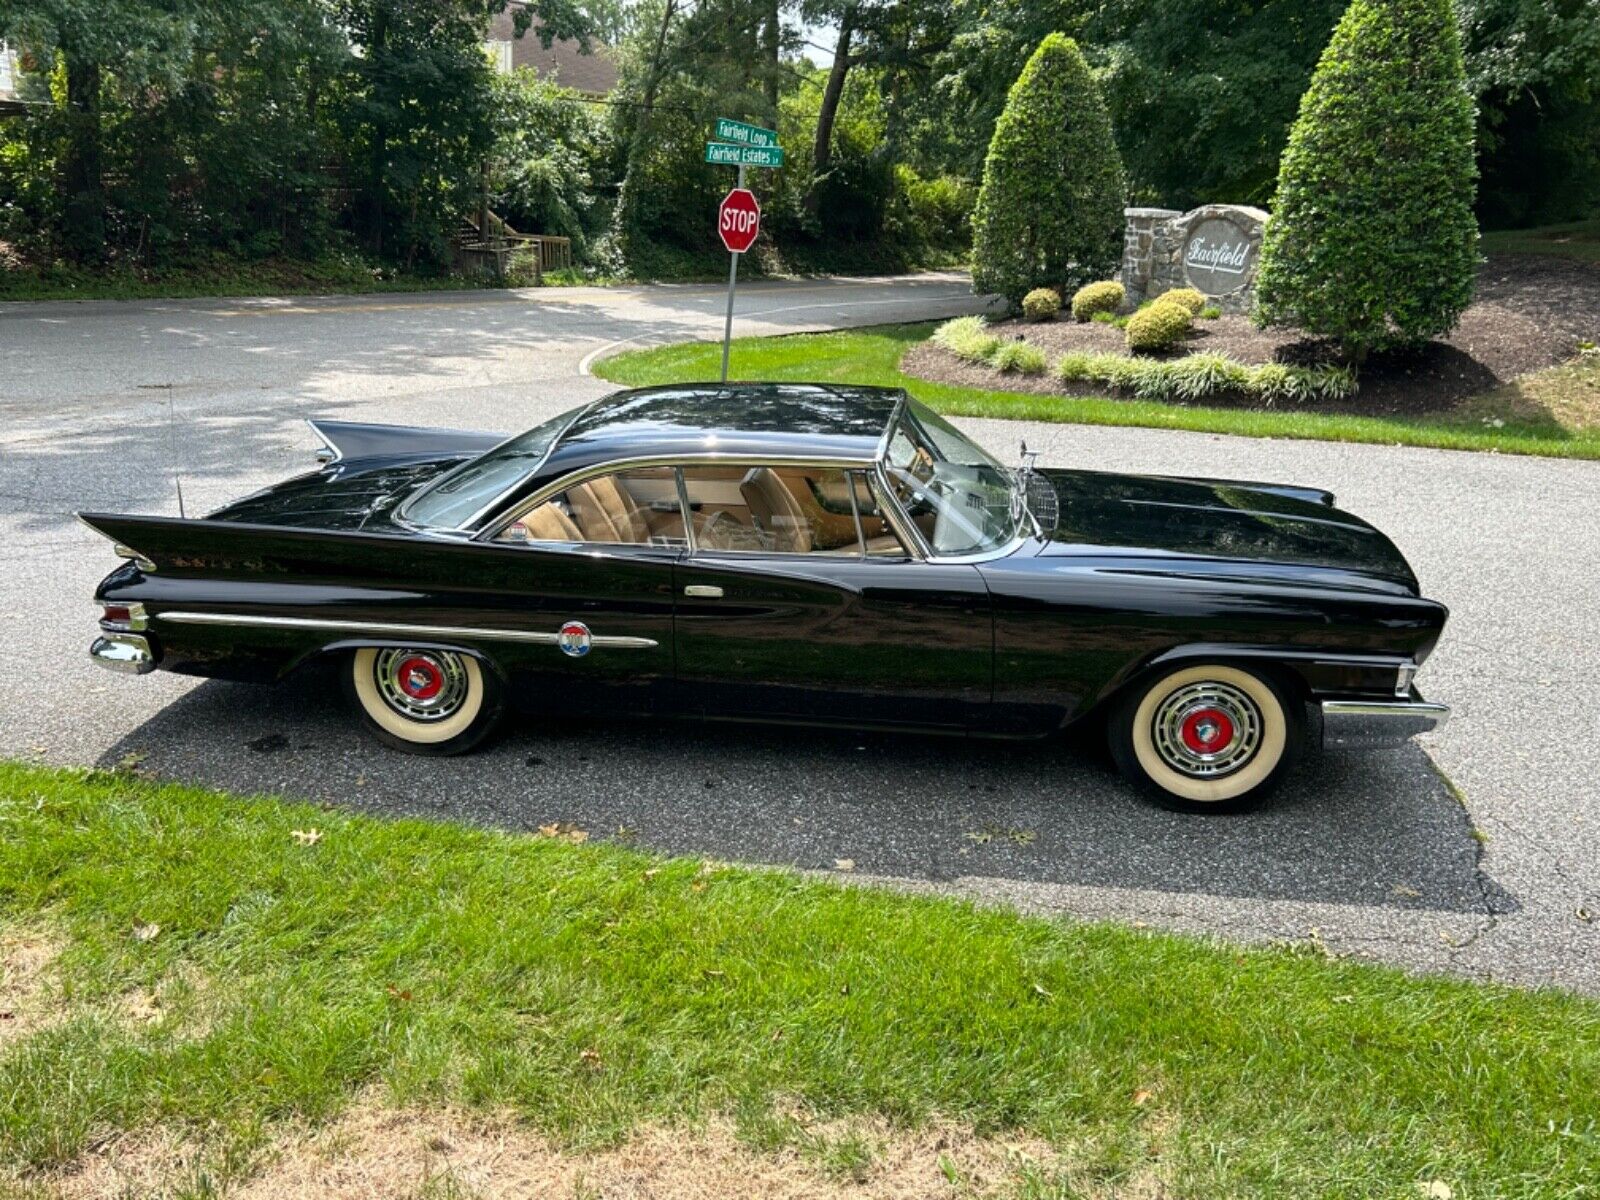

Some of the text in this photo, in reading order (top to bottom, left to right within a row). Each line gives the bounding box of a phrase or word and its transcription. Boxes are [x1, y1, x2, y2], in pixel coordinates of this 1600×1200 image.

[719, 121, 748, 141] Fairfield
[750, 129, 767, 147] Loop
[709, 146, 740, 161] Fairfield
[742, 148, 771, 164] Estates
[722, 208, 756, 234] STOP
[1188, 237, 1250, 273] Fairfield
